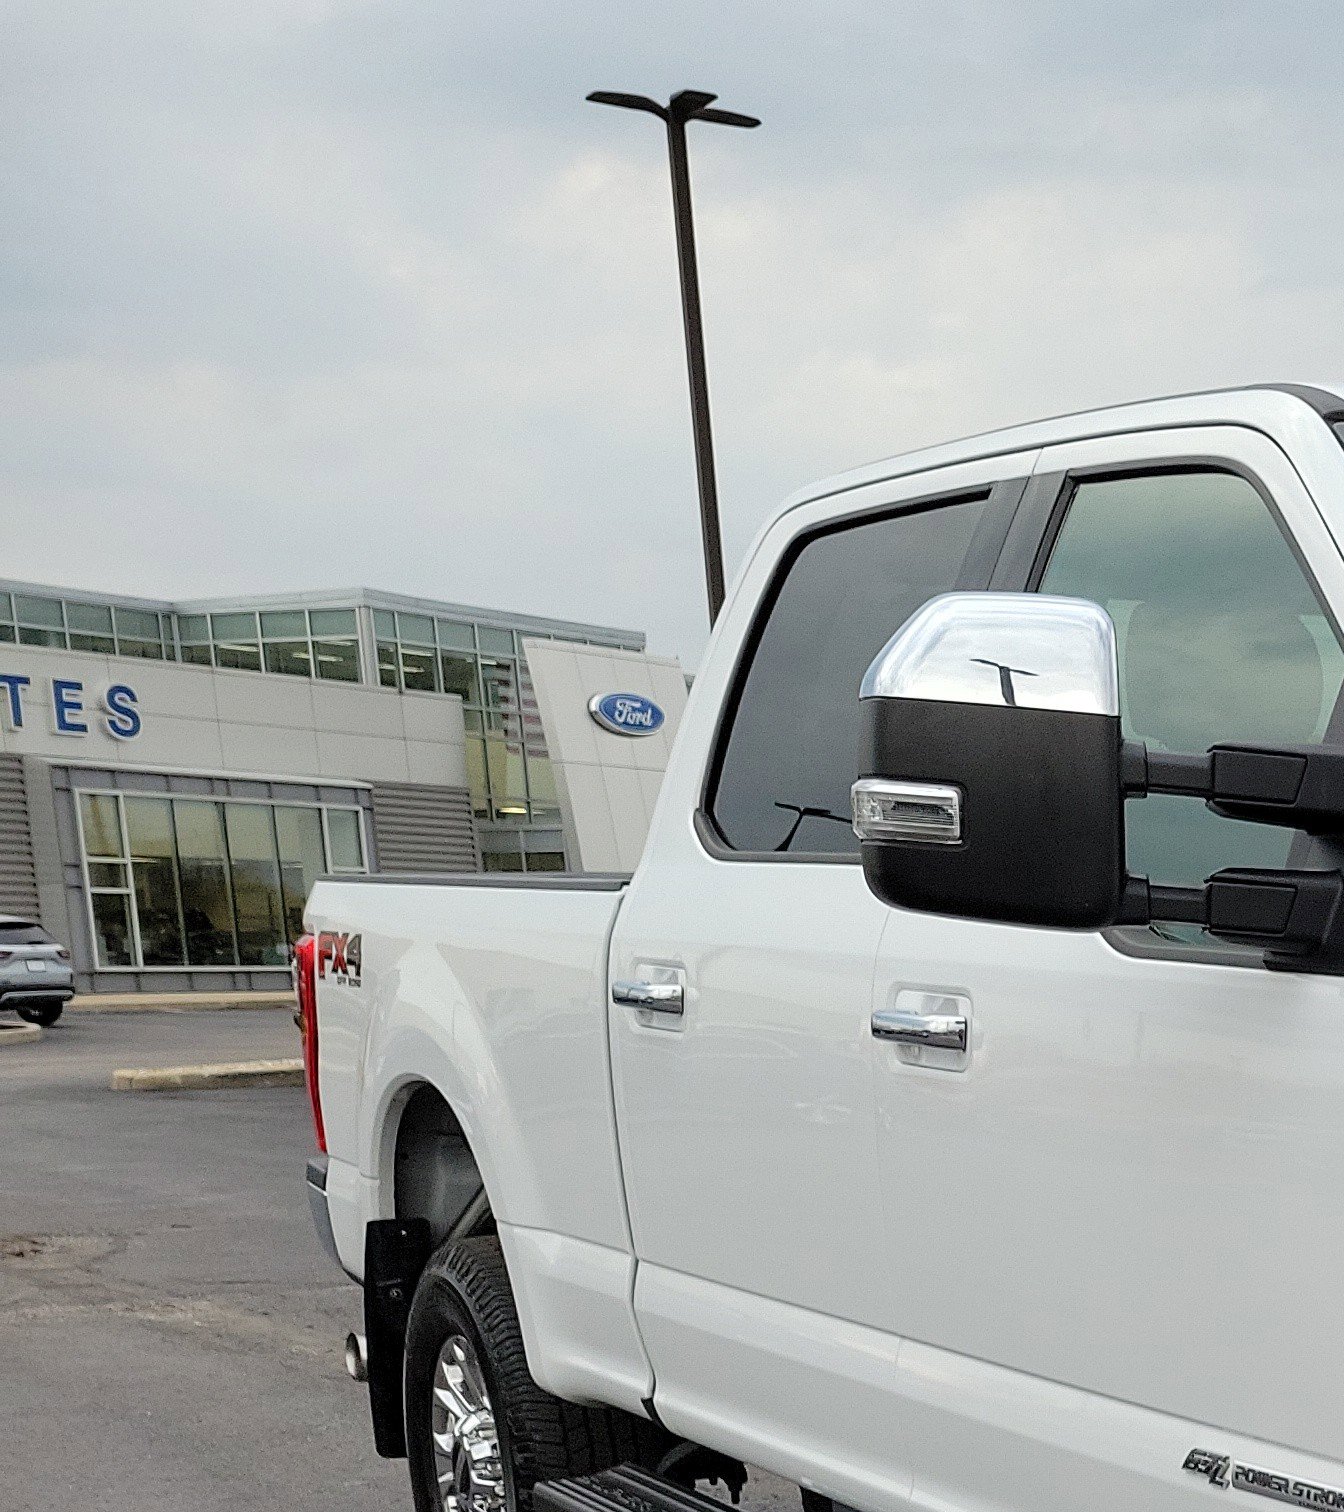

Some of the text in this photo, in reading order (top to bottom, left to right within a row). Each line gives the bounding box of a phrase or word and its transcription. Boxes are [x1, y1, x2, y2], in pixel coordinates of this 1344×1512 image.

[0, 674, 141, 738] TES
[614, 698, 653, 727] Ford
[318, 931, 362, 980] FX4
[1235, 1465, 1289, 1494] POWER
